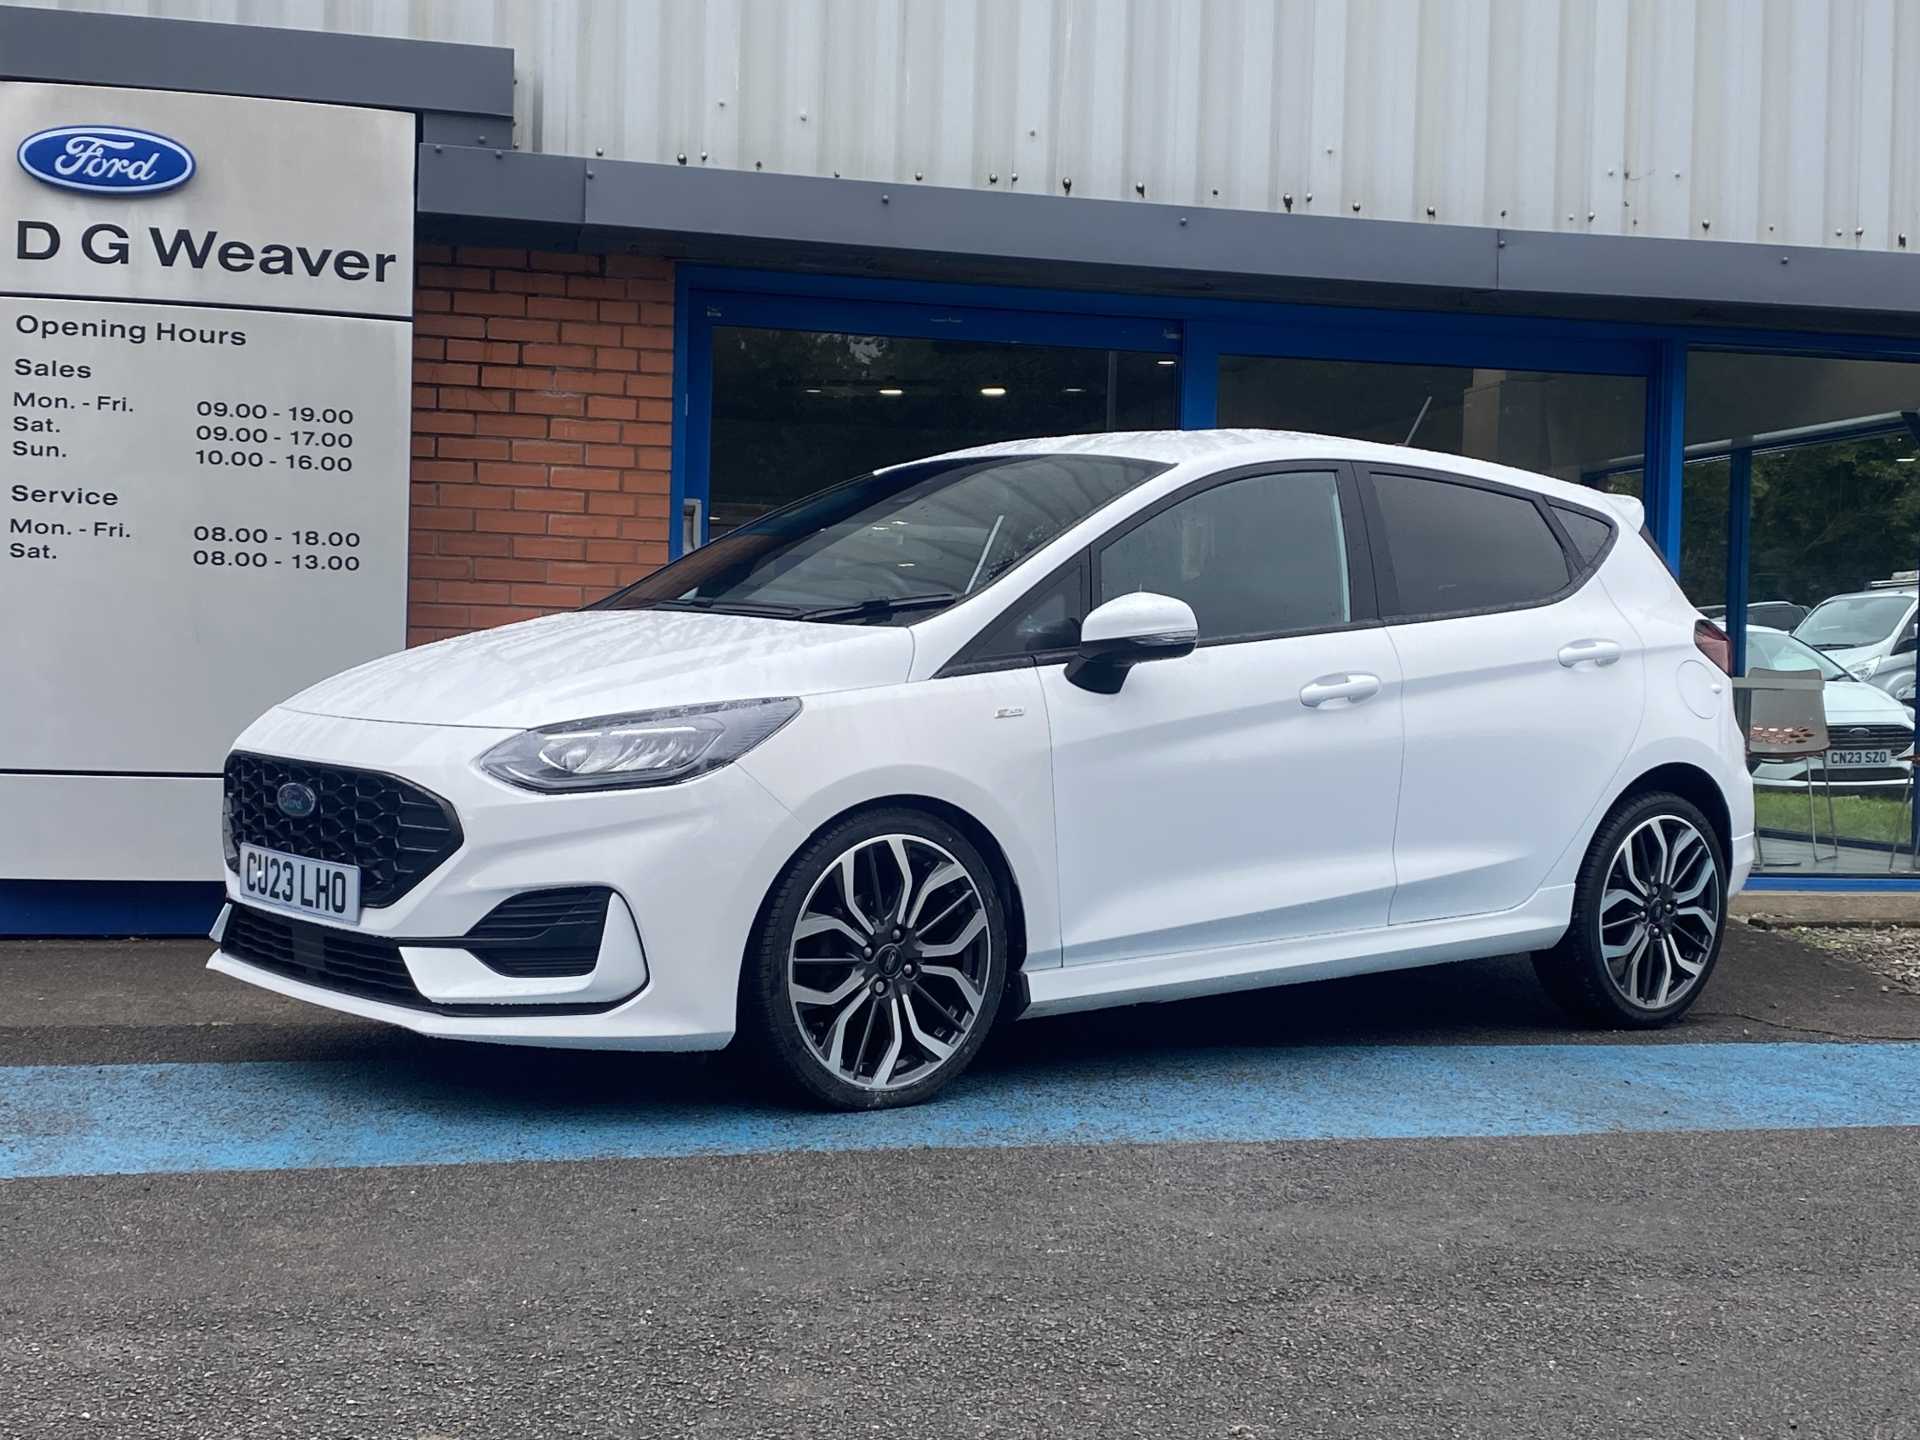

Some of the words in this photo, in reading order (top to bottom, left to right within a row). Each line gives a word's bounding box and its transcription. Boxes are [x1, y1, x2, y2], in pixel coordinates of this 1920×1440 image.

[54, 135, 161, 181] Ford
[17, 220, 61, 260] D
[81, 223, 130, 265] G
[149, 226, 397, 283] Weaver
[15, 314, 147, 345] Opening
[156, 322, 247, 346] Hours
[14, 358, 92, 379] Sales
[13, 391, 76, 410] Mon.
[97, 396, 134, 413] Fri.
[196, 400, 268, 420] 09.00
[288, 406, 354, 425] 19.00
[12, 415, 61, 433] Sat.
[195, 425, 268, 444] 09.00
[290, 430, 353, 449] 17.00
[12, 440, 67, 458] Sun.
[195, 449, 264, 468] 10.00
[285, 454, 353, 473] 16.00
[10, 484, 119, 506] Service
[9, 518, 72, 536] Mon.
[93, 522, 131, 538] Fri.
[193, 525, 268, 544] 08.00
[291, 530, 361, 548] 18.00
[9, 542, 57, 560] Sat.
[192, 549, 268, 568] 08.00
[291, 554, 360, 572] 13.00
[1831, 751, 1862, 764] CN23
[246, 851, 294, 902] CU23
[300, 864, 347, 914] LHO
